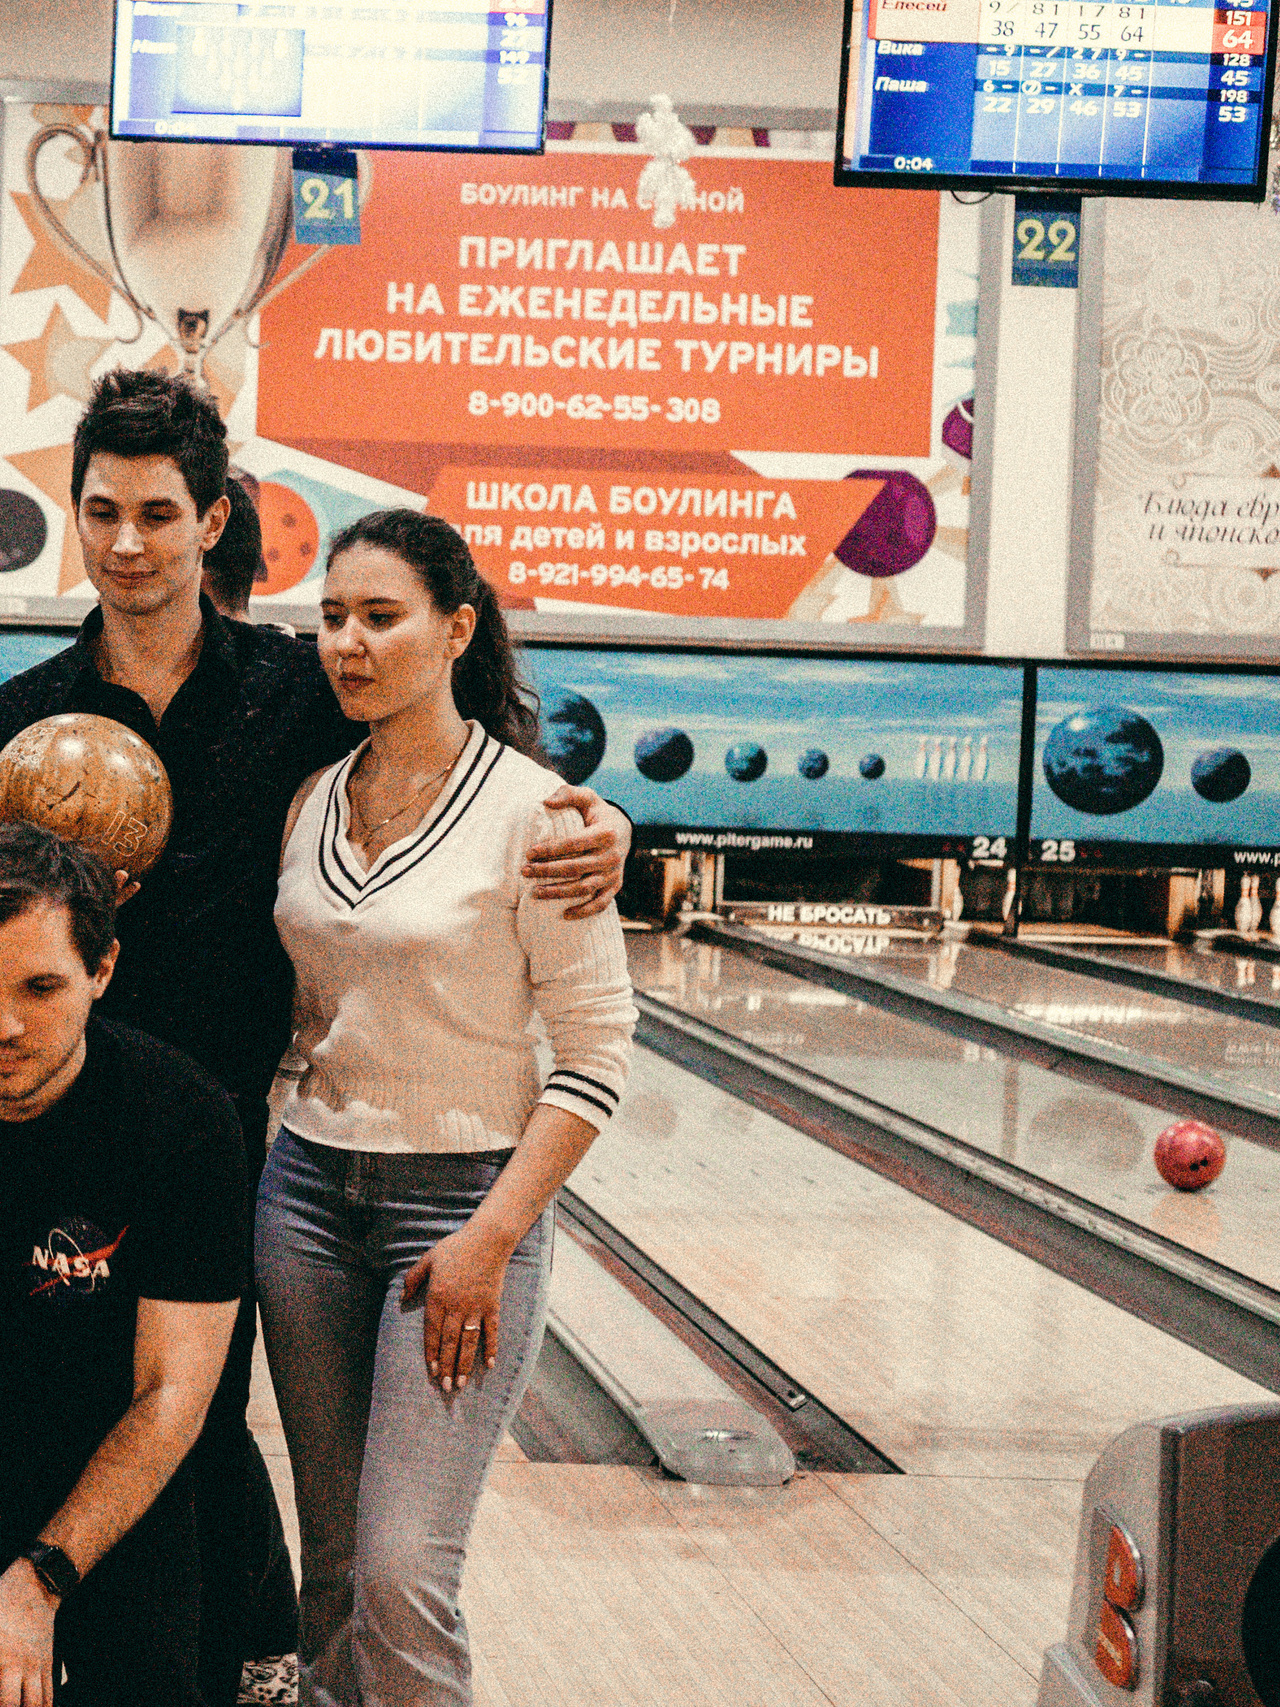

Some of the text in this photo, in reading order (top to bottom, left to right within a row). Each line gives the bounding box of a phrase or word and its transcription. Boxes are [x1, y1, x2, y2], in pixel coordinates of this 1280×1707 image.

[1225, 10, 1252, 26] 151
[991, 20, 1253, 49] 38 47 55 64 64
[877, 40, 925, 57] Вика
[1222, 53, 1250, 67] 128
[989, 61, 1249, 87] 15 27 36 45 45
[875, 76, 928, 93] Паша
[1219, 89, 1248, 104] 198
[983, 98, 1247, 123] 22 29 46 53 53
[893, 155, 934, 171] 0:04
[299, 177, 355, 220] 21
[460, 182, 585, 209] БОУЛИНГ
[591, 186, 629, 209] НА
[1016, 218, 1077, 264] 22
[458, 235, 747, 277] ПРИГЛАШАЕТ
[386, 281, 814, 328] НА ЕЖЕНЕДЕЛЬНЫЕ
[314, 327, 880, 379] ЛЮБИТЕЛЬСКИЕ ТУРНИРЫ
[465, 480, 799, 520] ШКОЛА БОУЛИНГА
[510, 521, 606, 551] детей
[615, 528, 636, 549] и
[644, 530, 807, 559] взрослых
[675, 830, 815, 852] www.pitergame.ru
[972, 836, 1076, 864] 24 25
[767, 904, 892, 926] НЕ БРОСАТЬ
[31, 1244, 111, 1279] NASA
